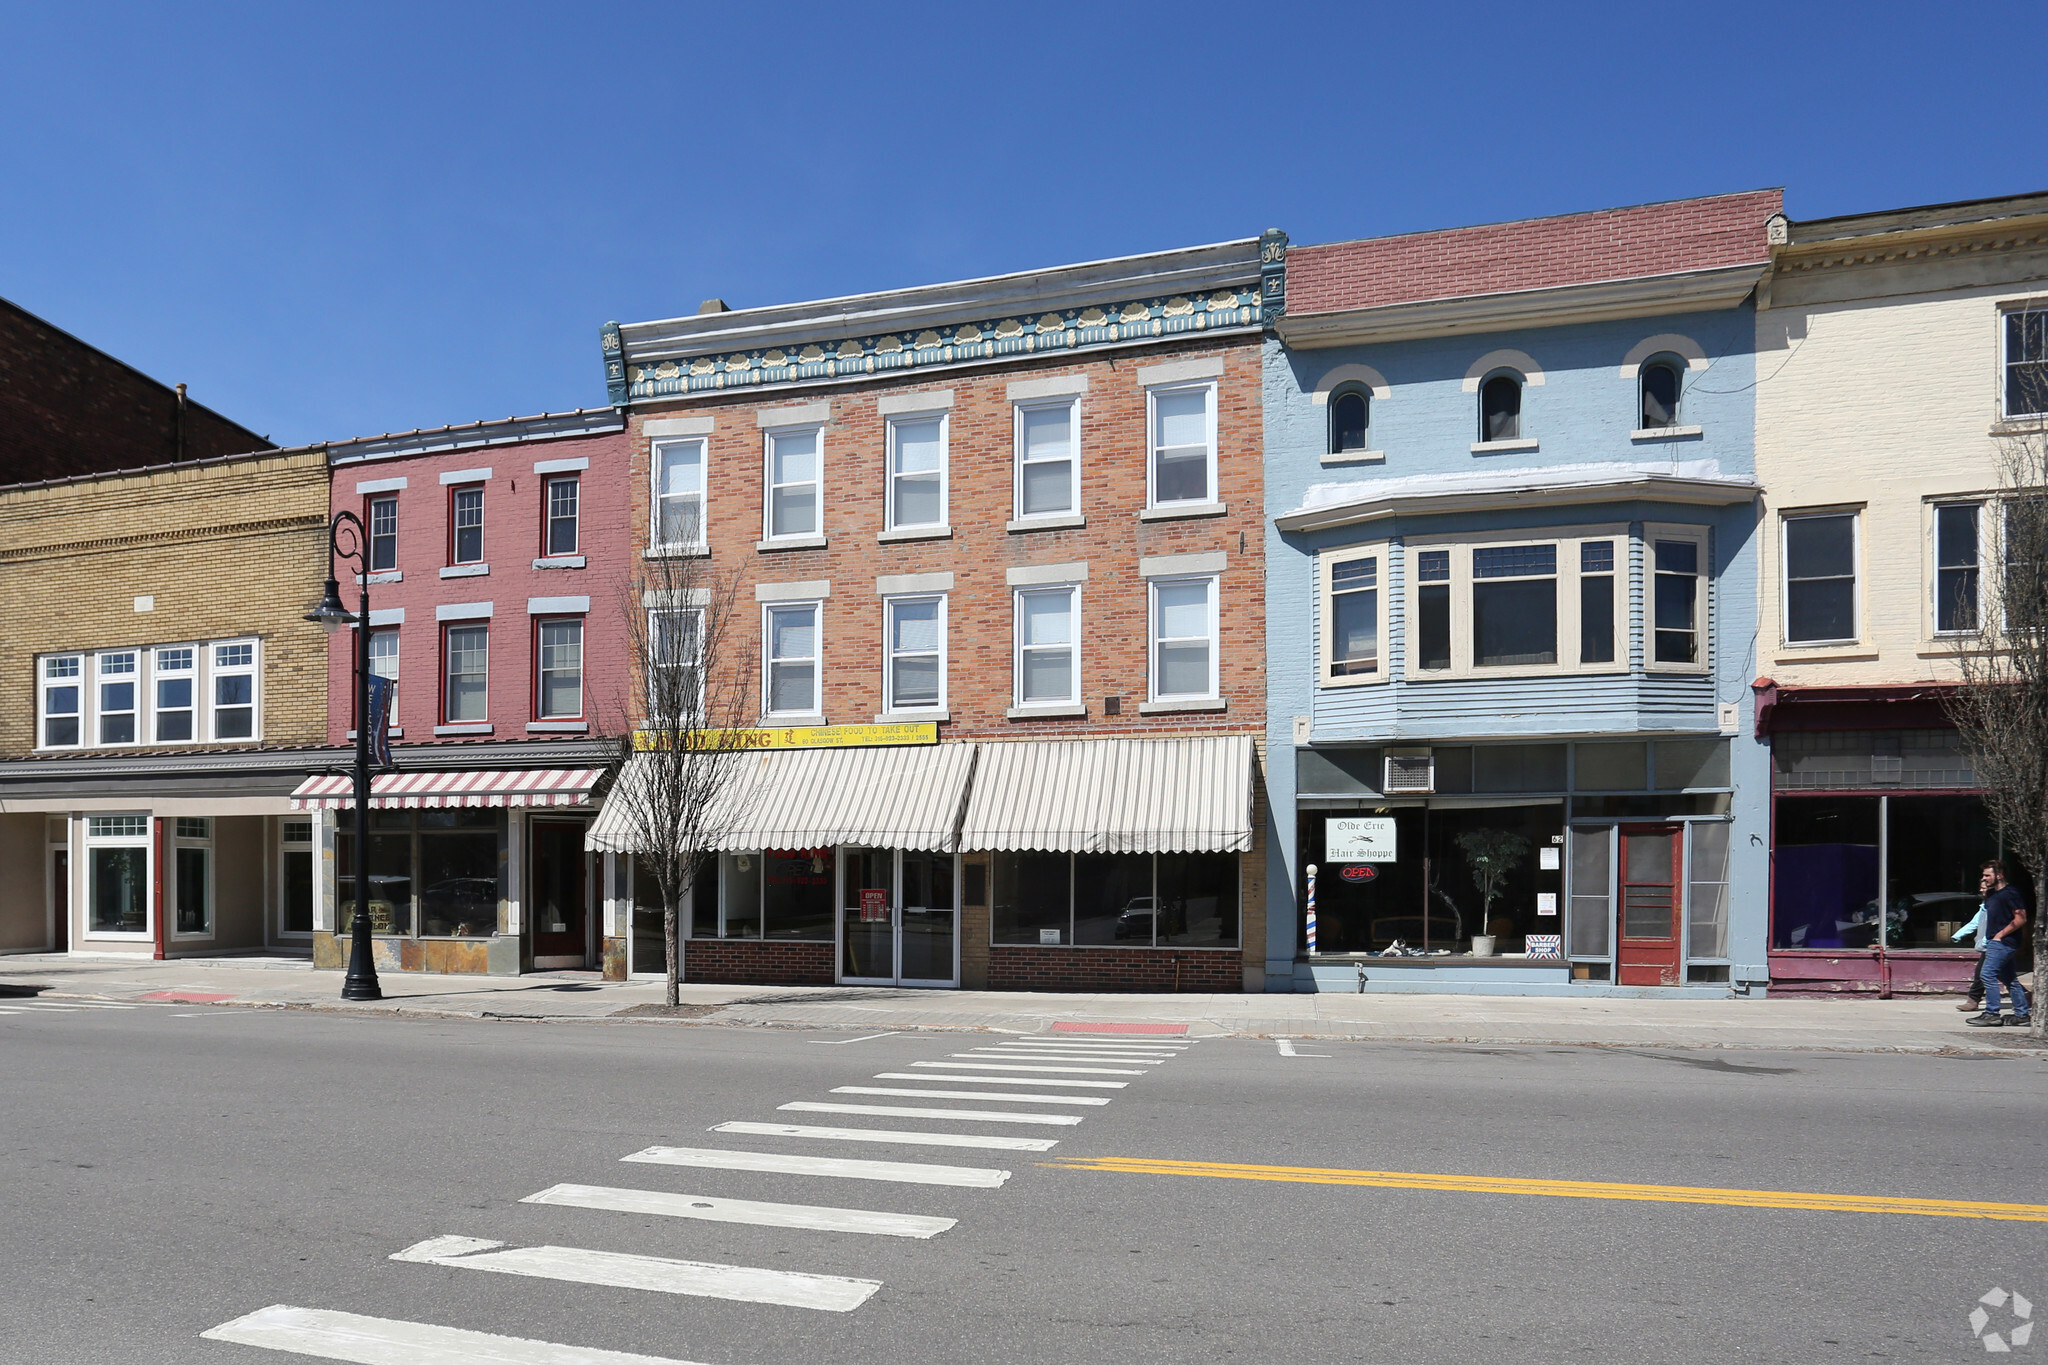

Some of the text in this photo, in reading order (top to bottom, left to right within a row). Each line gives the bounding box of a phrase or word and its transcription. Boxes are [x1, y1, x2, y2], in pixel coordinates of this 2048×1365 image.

[368, 683, 376, 755] WELCOME
[810, 725, 919, 737] CHINESE FOOD TO TAKE OUT
[657, 733, 706, 750] FOD
[719, 732, 772, 748] KING
[811, 737, 834, 745] GLASGOW
[1337, 821, 1385, 830] Olde Erie
[1330, 848, 1393, 858] Hair Shoppe
[1342, 867, 1375, 878] OPEN
